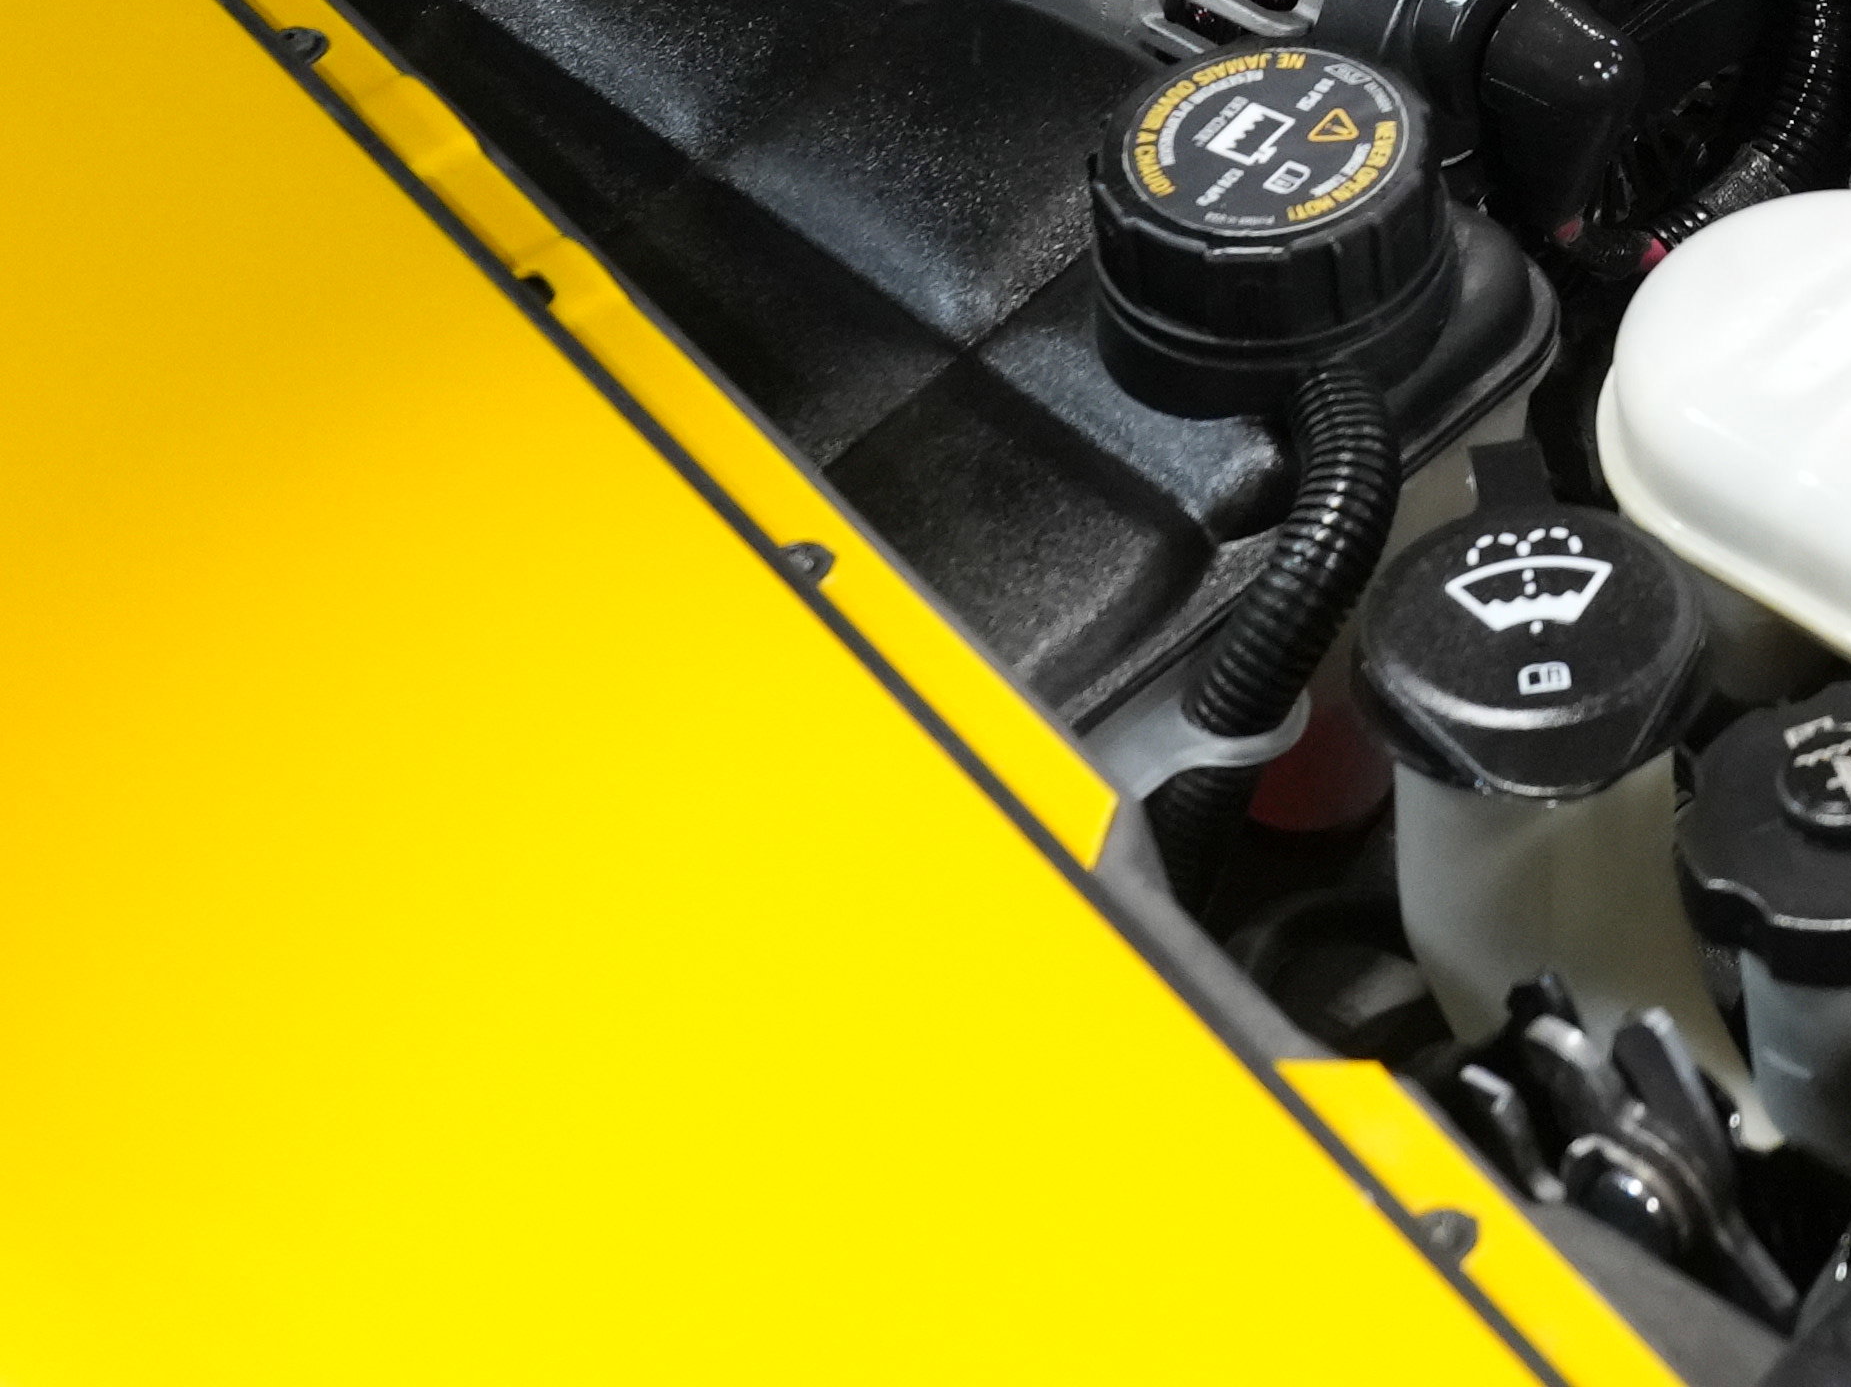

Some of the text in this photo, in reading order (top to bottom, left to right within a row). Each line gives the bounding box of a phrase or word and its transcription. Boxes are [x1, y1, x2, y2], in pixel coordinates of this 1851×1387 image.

[1192, 52, 1272, 87] JAMAIS
[1276, 52, 1306, 70] NE
[1366, 120, 1398, 168] NEVER
[1330, 165, 1380, 203] OPEN
[1285, 194, 1337, 222] HOT!
